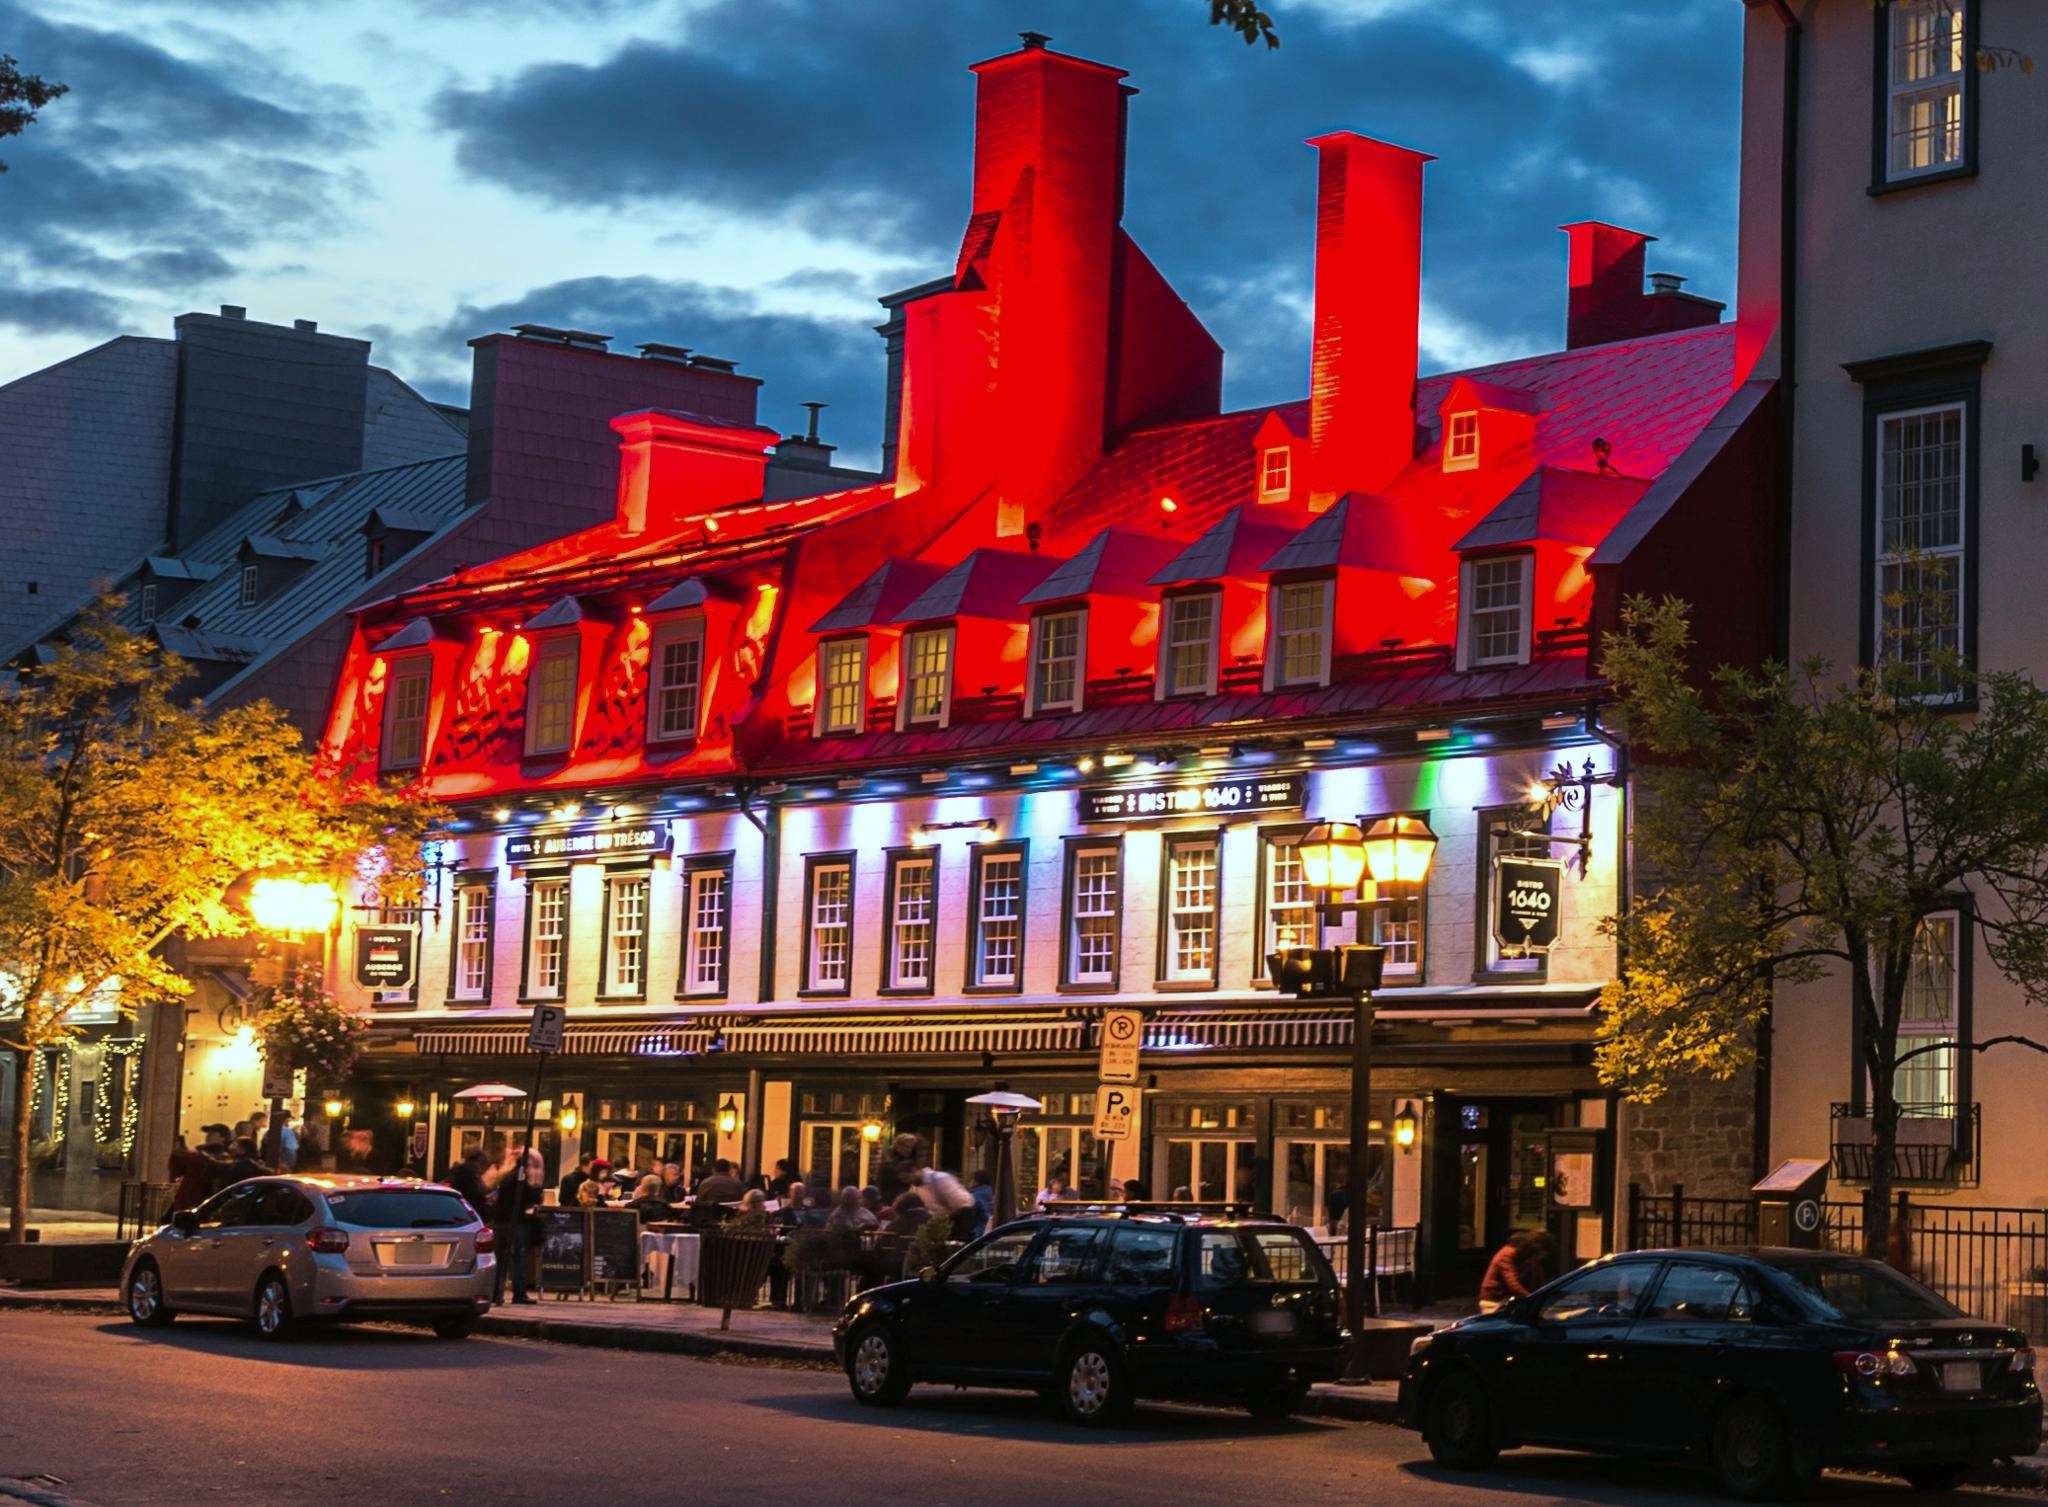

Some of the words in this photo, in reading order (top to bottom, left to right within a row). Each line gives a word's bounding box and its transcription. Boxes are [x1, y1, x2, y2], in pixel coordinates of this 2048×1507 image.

[1203, 786, 1241, 807] 1640
[613, 830, 655, 847] TRÉSOR
[1508, 889, 1551, 910] 1640
